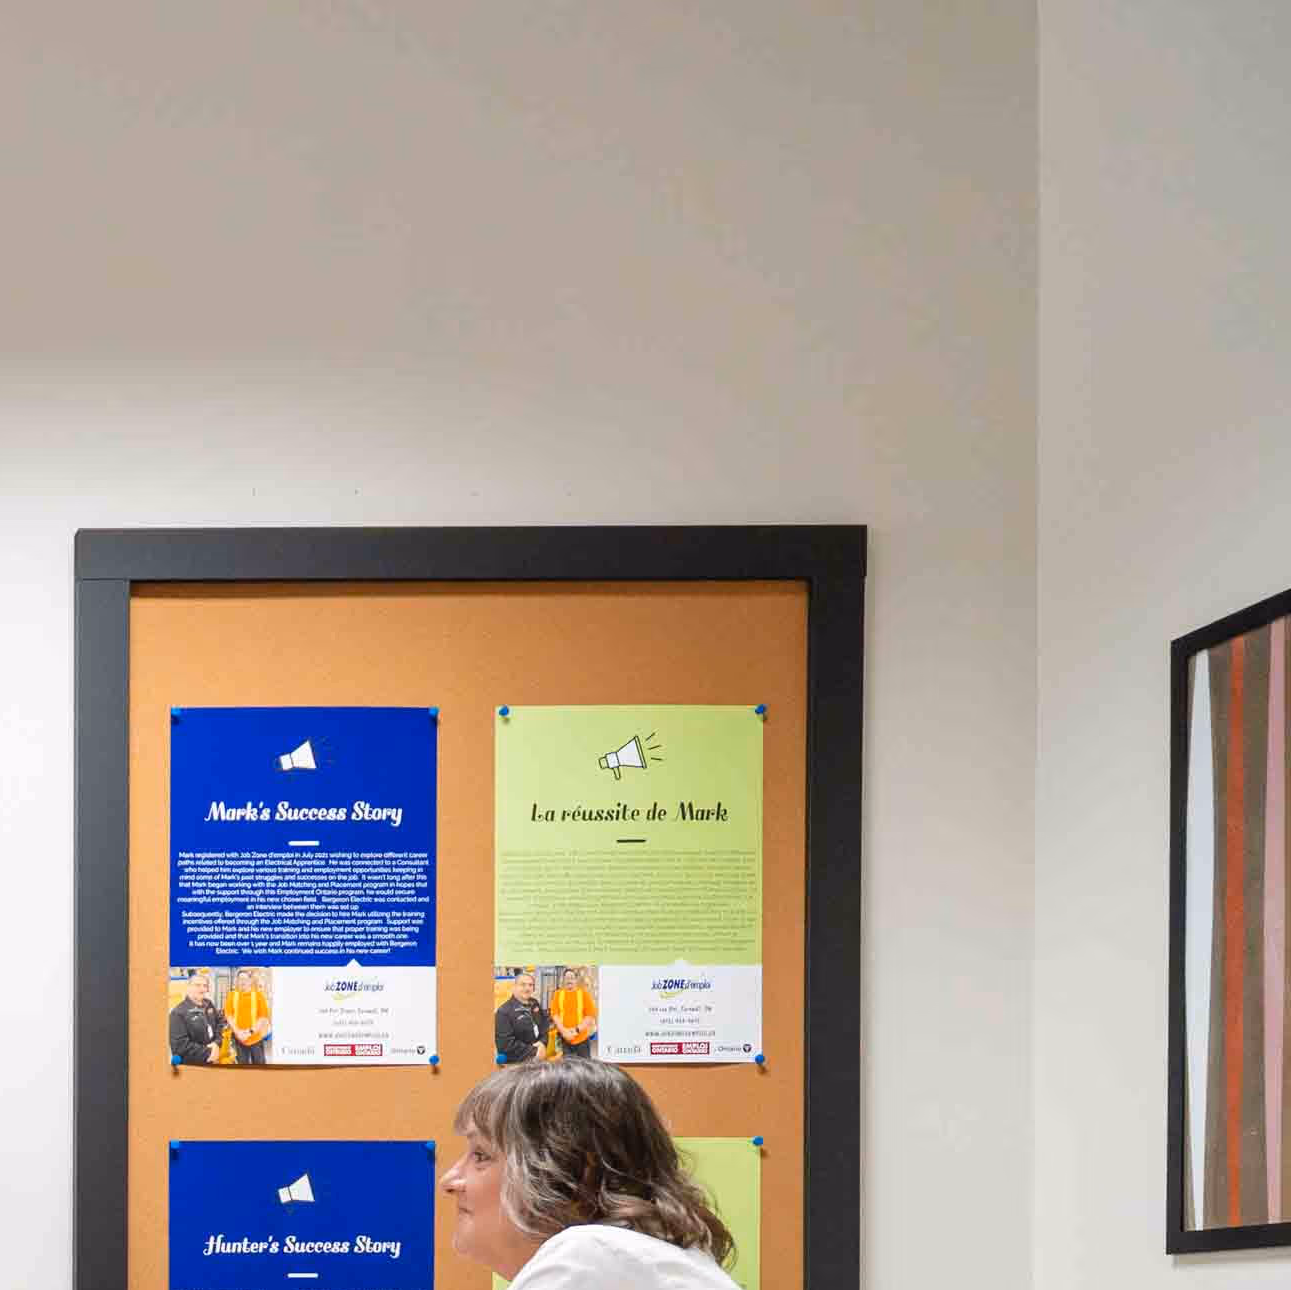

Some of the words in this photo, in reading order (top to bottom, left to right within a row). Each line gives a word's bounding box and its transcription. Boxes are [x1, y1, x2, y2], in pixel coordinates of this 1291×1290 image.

[204, 801, 271, 821] Mark's
[275, 801, 347, 821] Success
[351, 801, 403, 827] Story
[531, 803, 555, 822] La
[561, 802, 640, 822] réussite
[646, 802, 667, 822] de
[675, 801, 729, 822] Mark
[203, 1235, 279, 1256] Hunter's
[283, 1235, 349, 1254] Success
[354, 1235, 401, 1258] Story
